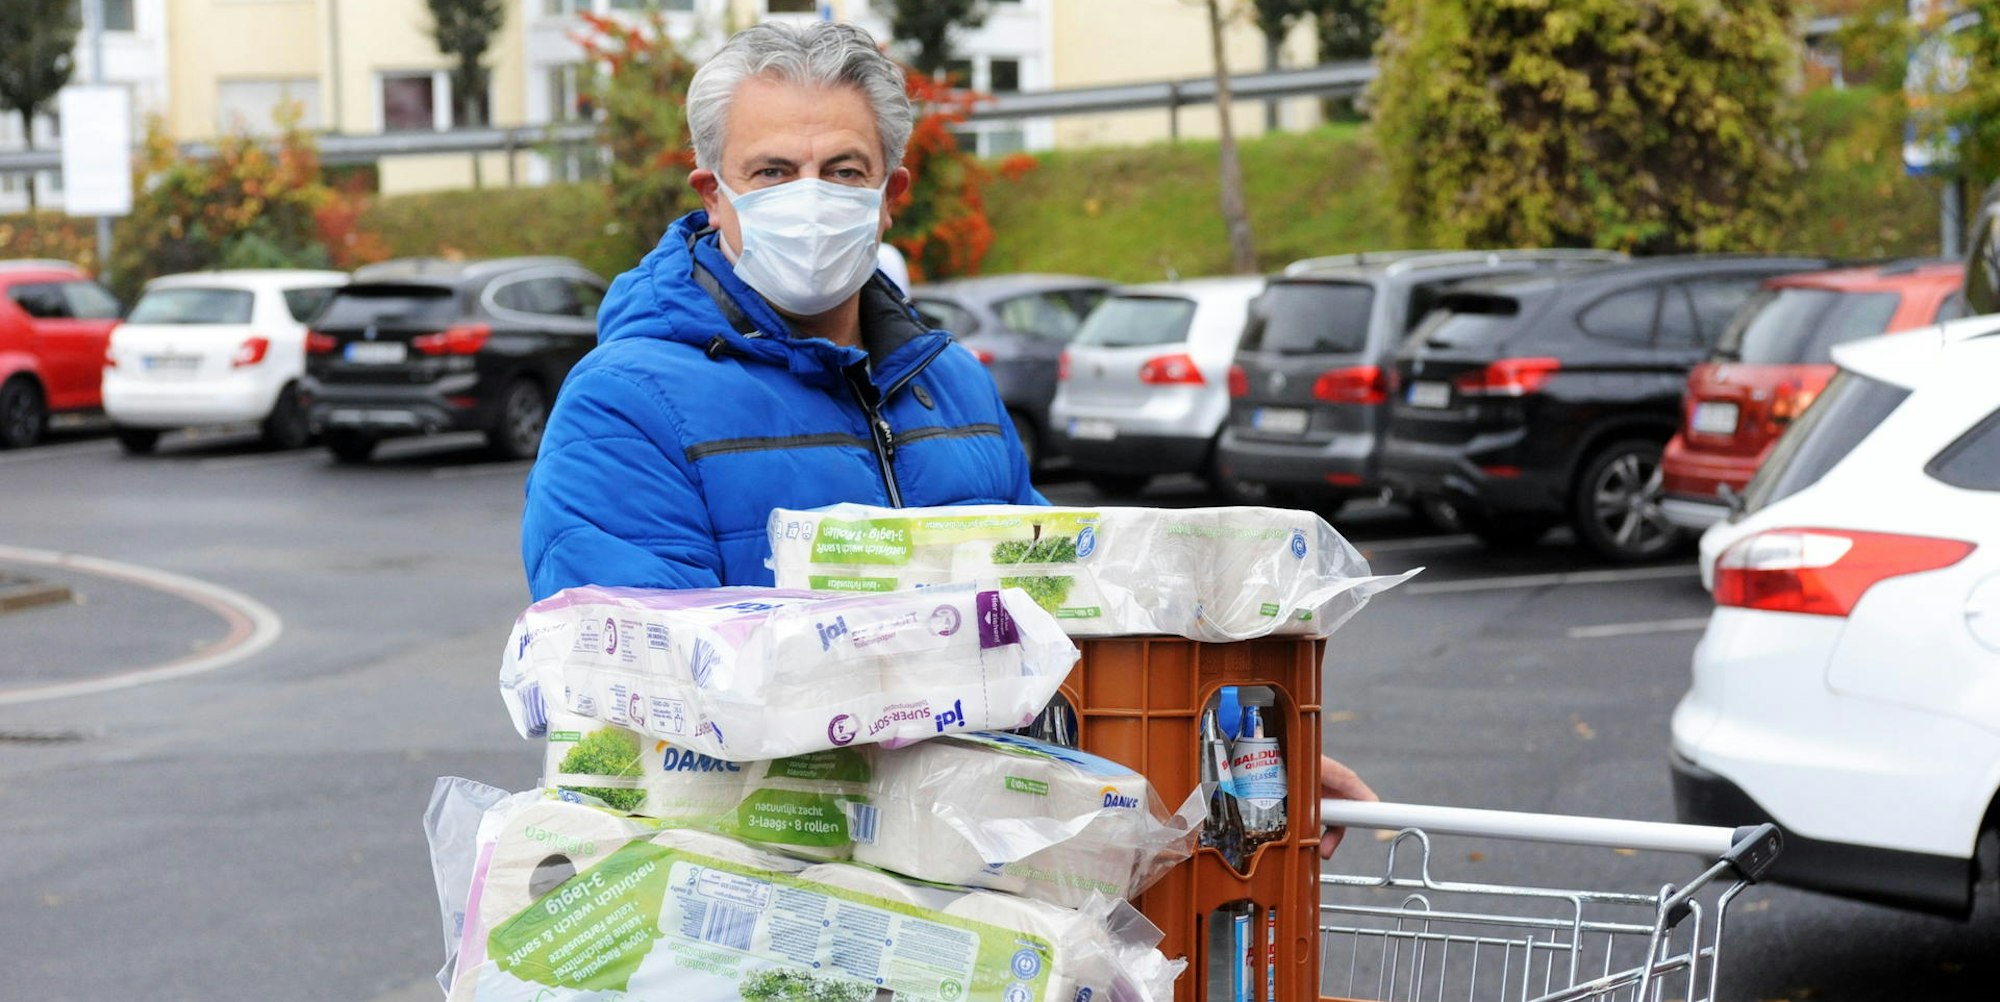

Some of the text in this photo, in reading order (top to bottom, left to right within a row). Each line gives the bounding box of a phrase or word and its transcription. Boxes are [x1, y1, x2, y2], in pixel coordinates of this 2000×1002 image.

[815, 616, 848, 651] ja!
[991, 594, 1001, 643] Hier ziehen!
[868, 699, 966, 736] ja! SUPER-SOFT
[1233, 749, 1281, 767] BALDUI
[1245, 759, 1279, 770] QUELLE
[748, 814, 839, 833] 3-laags 8 rollen
[755, 802, 823, 818] natuurlijk zacht
[544, 871, 606, 916] 3-lagig
[505, 860, 656, 968] natürlich weich & sanft
[612, 914, 643, 938] keine
[547, 902, 635, 964] keine Farbzusätze
[552, 938, 615, 979] Bleichmittel
[571, 926, 649, 983] 100% Recycling
